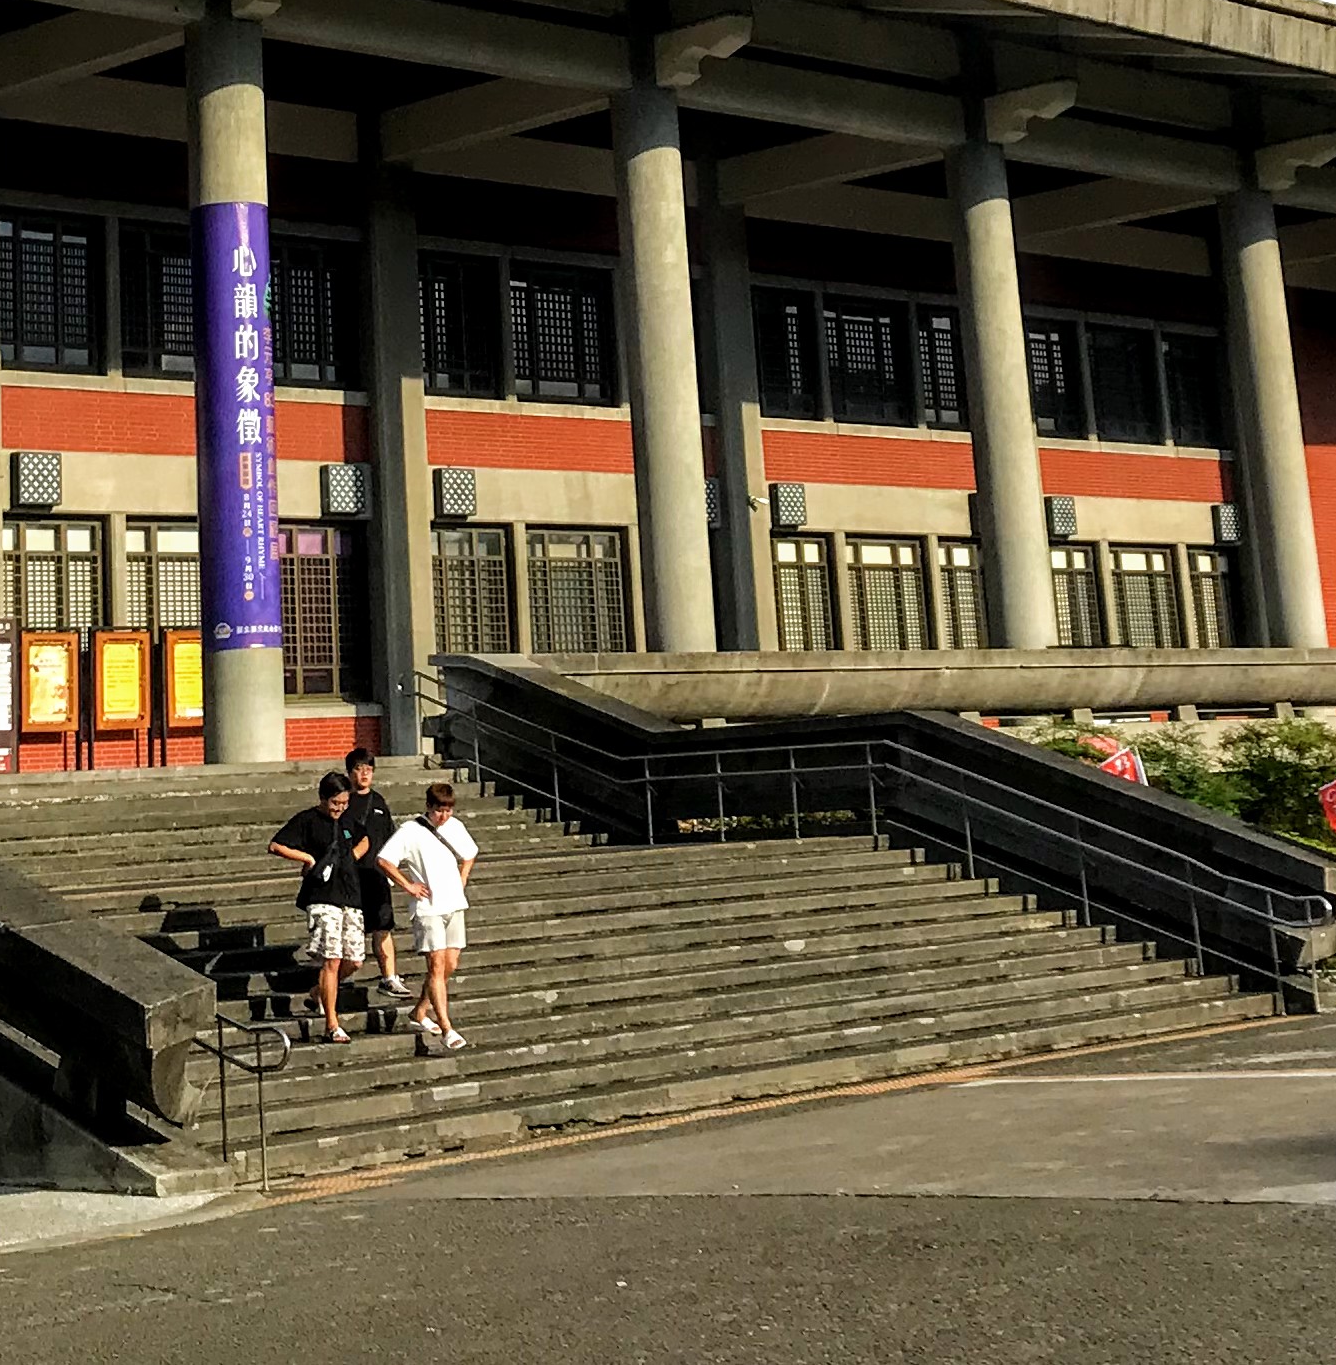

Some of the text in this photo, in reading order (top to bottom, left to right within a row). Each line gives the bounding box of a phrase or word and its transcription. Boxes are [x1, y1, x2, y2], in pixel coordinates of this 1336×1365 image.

[232, 245, 262, 445] 心韻的象徵
